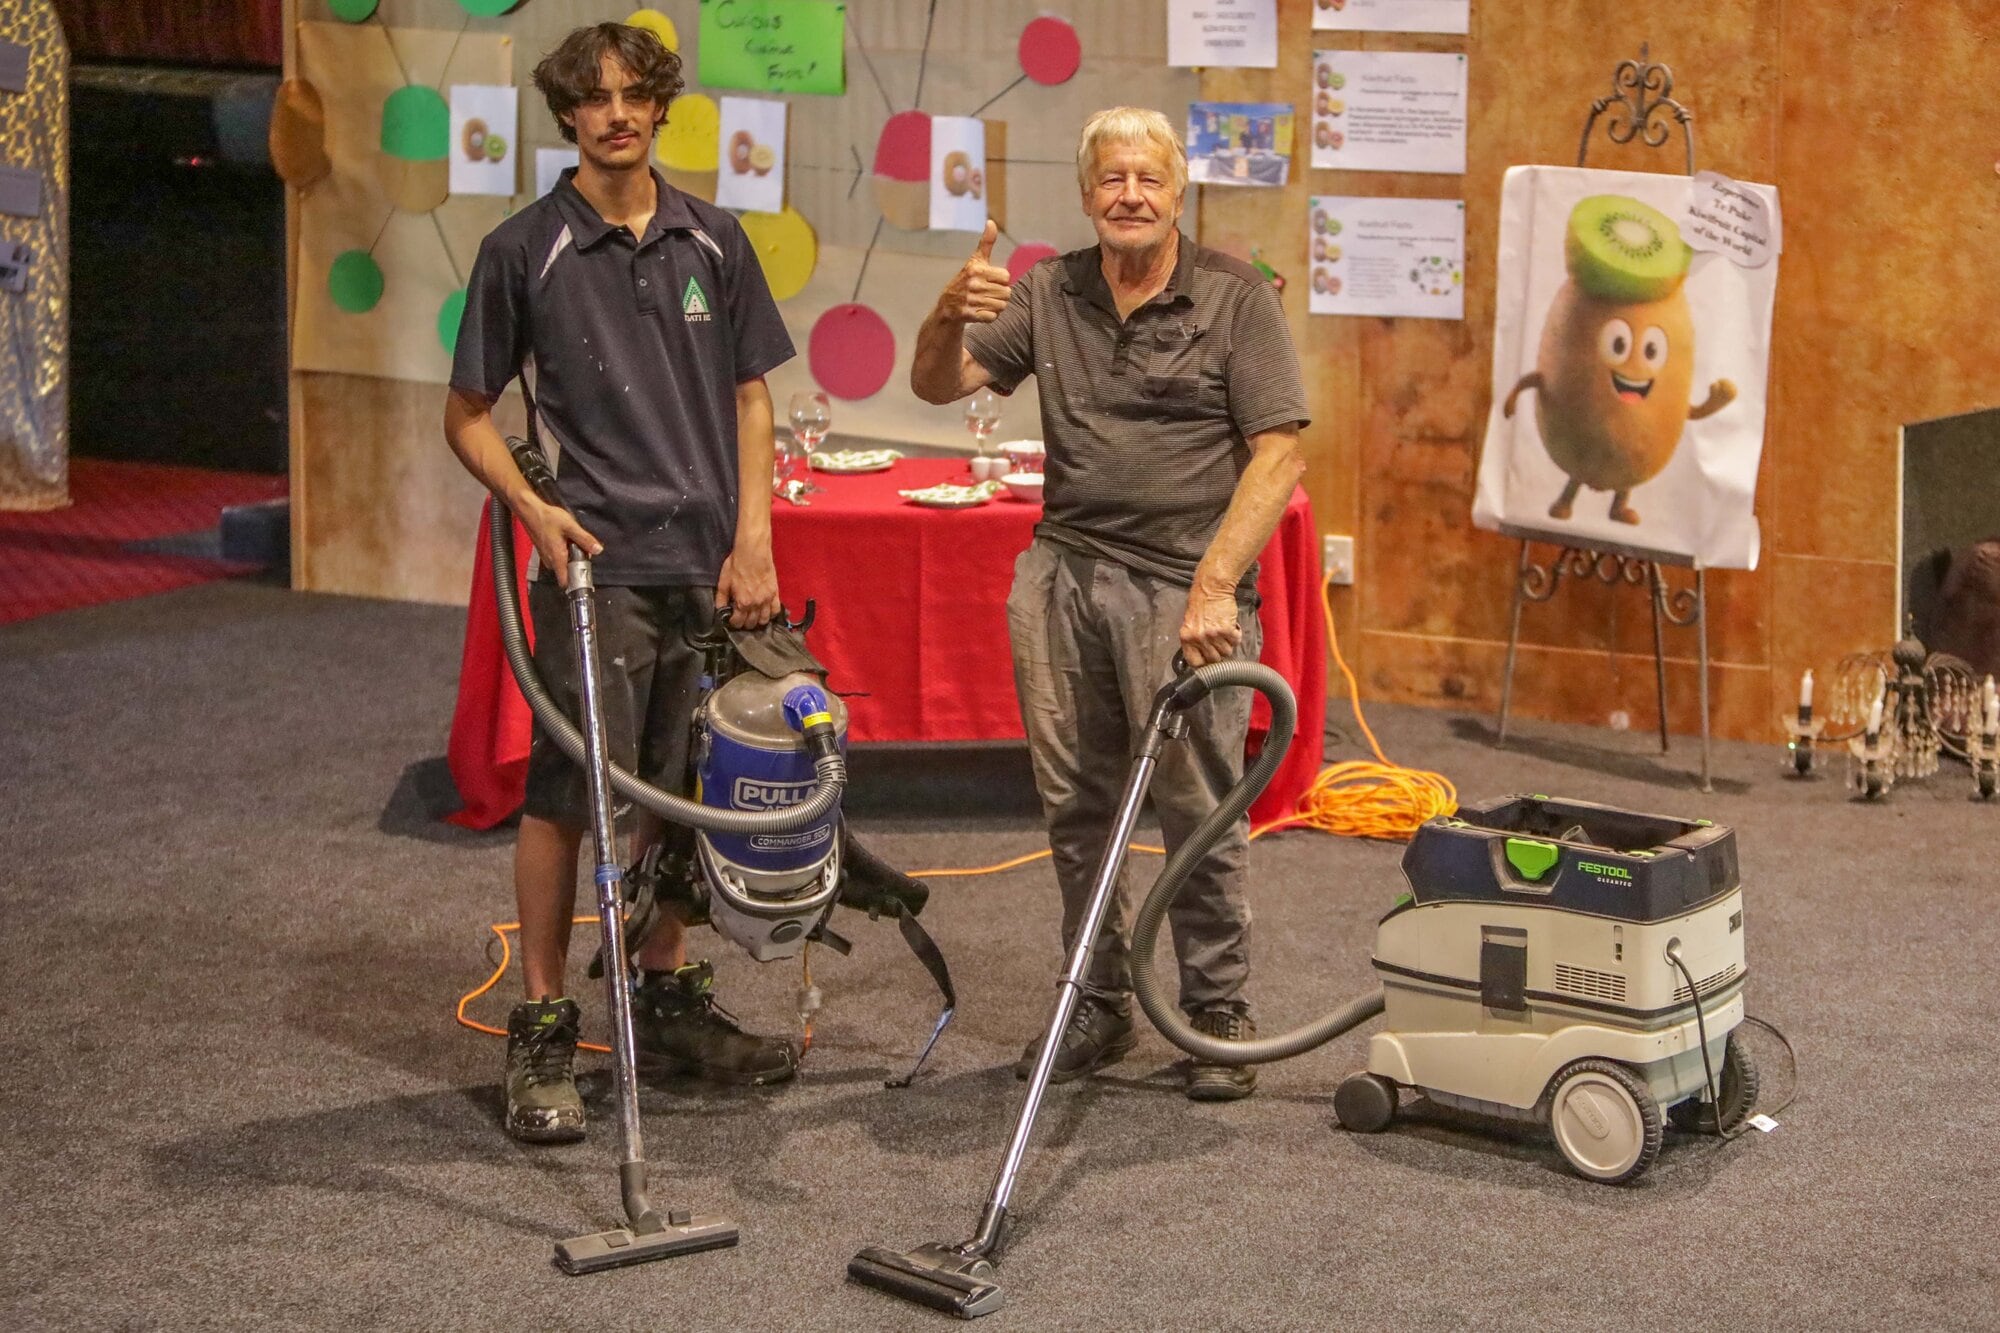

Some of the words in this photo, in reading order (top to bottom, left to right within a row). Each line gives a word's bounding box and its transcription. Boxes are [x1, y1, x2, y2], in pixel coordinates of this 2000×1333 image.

[744, 786, 816, 804] PULL
[758, 836, 812, 846] COMMANDER
[1578, 862, 1632, 879] FESTOOL
[1597, 877, 1632, 887] CLEANTEC
